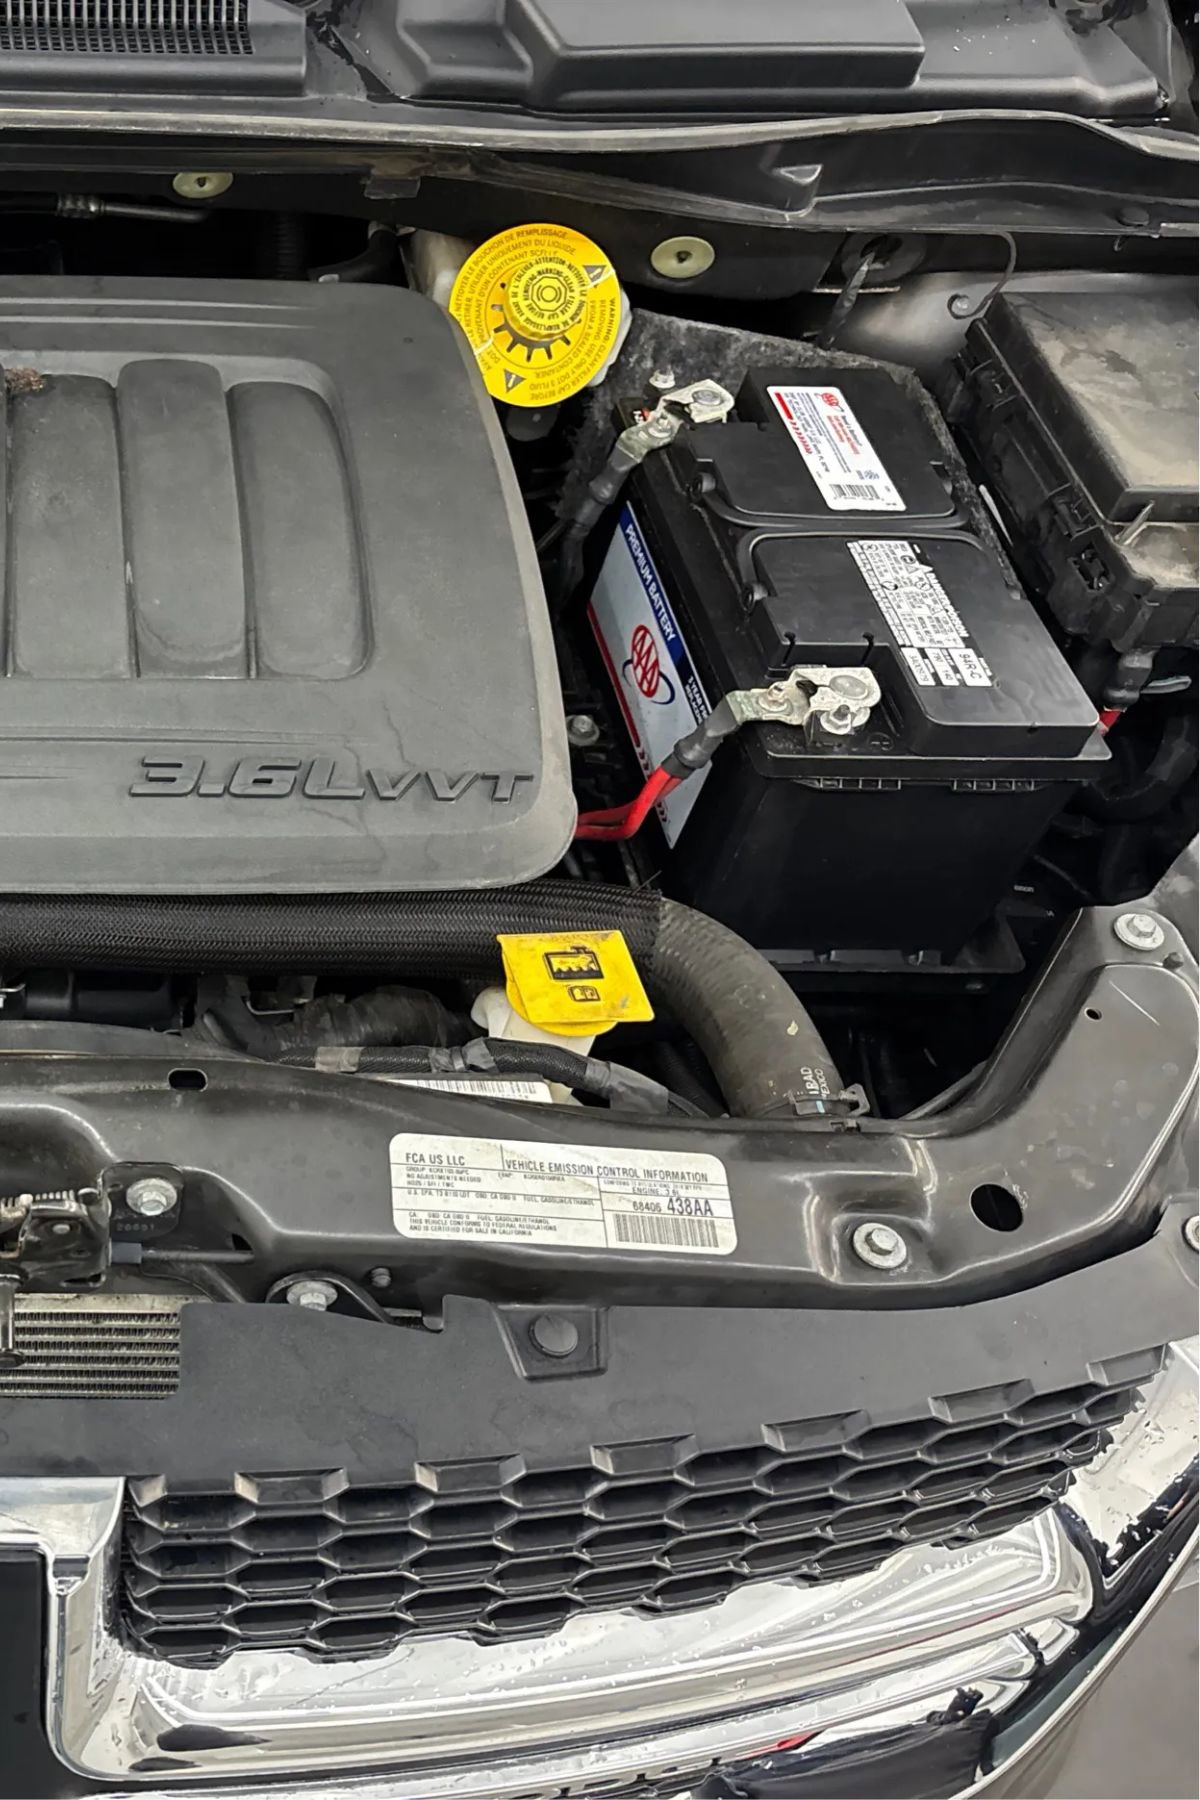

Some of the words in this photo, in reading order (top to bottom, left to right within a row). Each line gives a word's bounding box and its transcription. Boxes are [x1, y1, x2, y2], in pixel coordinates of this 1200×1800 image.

[516, 228, 567, 239] REMPLISSAGE
[624, 523, 654, 586] PREMIUM
[647, 582, 677, 642] BATTERY
[632, 624, 660, 698] AAA
[129, 756, 365, 800] 3.6L
[366, 769, 535, 803] VVT
[405, 1152, 426, 1163] FCA
[428, 1153, 444, 1165] US
[446, 1155, 466, 1166] LLC
[505, 1159, 545, 1172] VEHICLE
[548, 1162, 594, 1175] EMISSION
[596, 1166, 640, 1178] CONTROL
[643, 1168, 708, 1182] INFORMATION
[666, 1197, 715, 1217] 438AA
